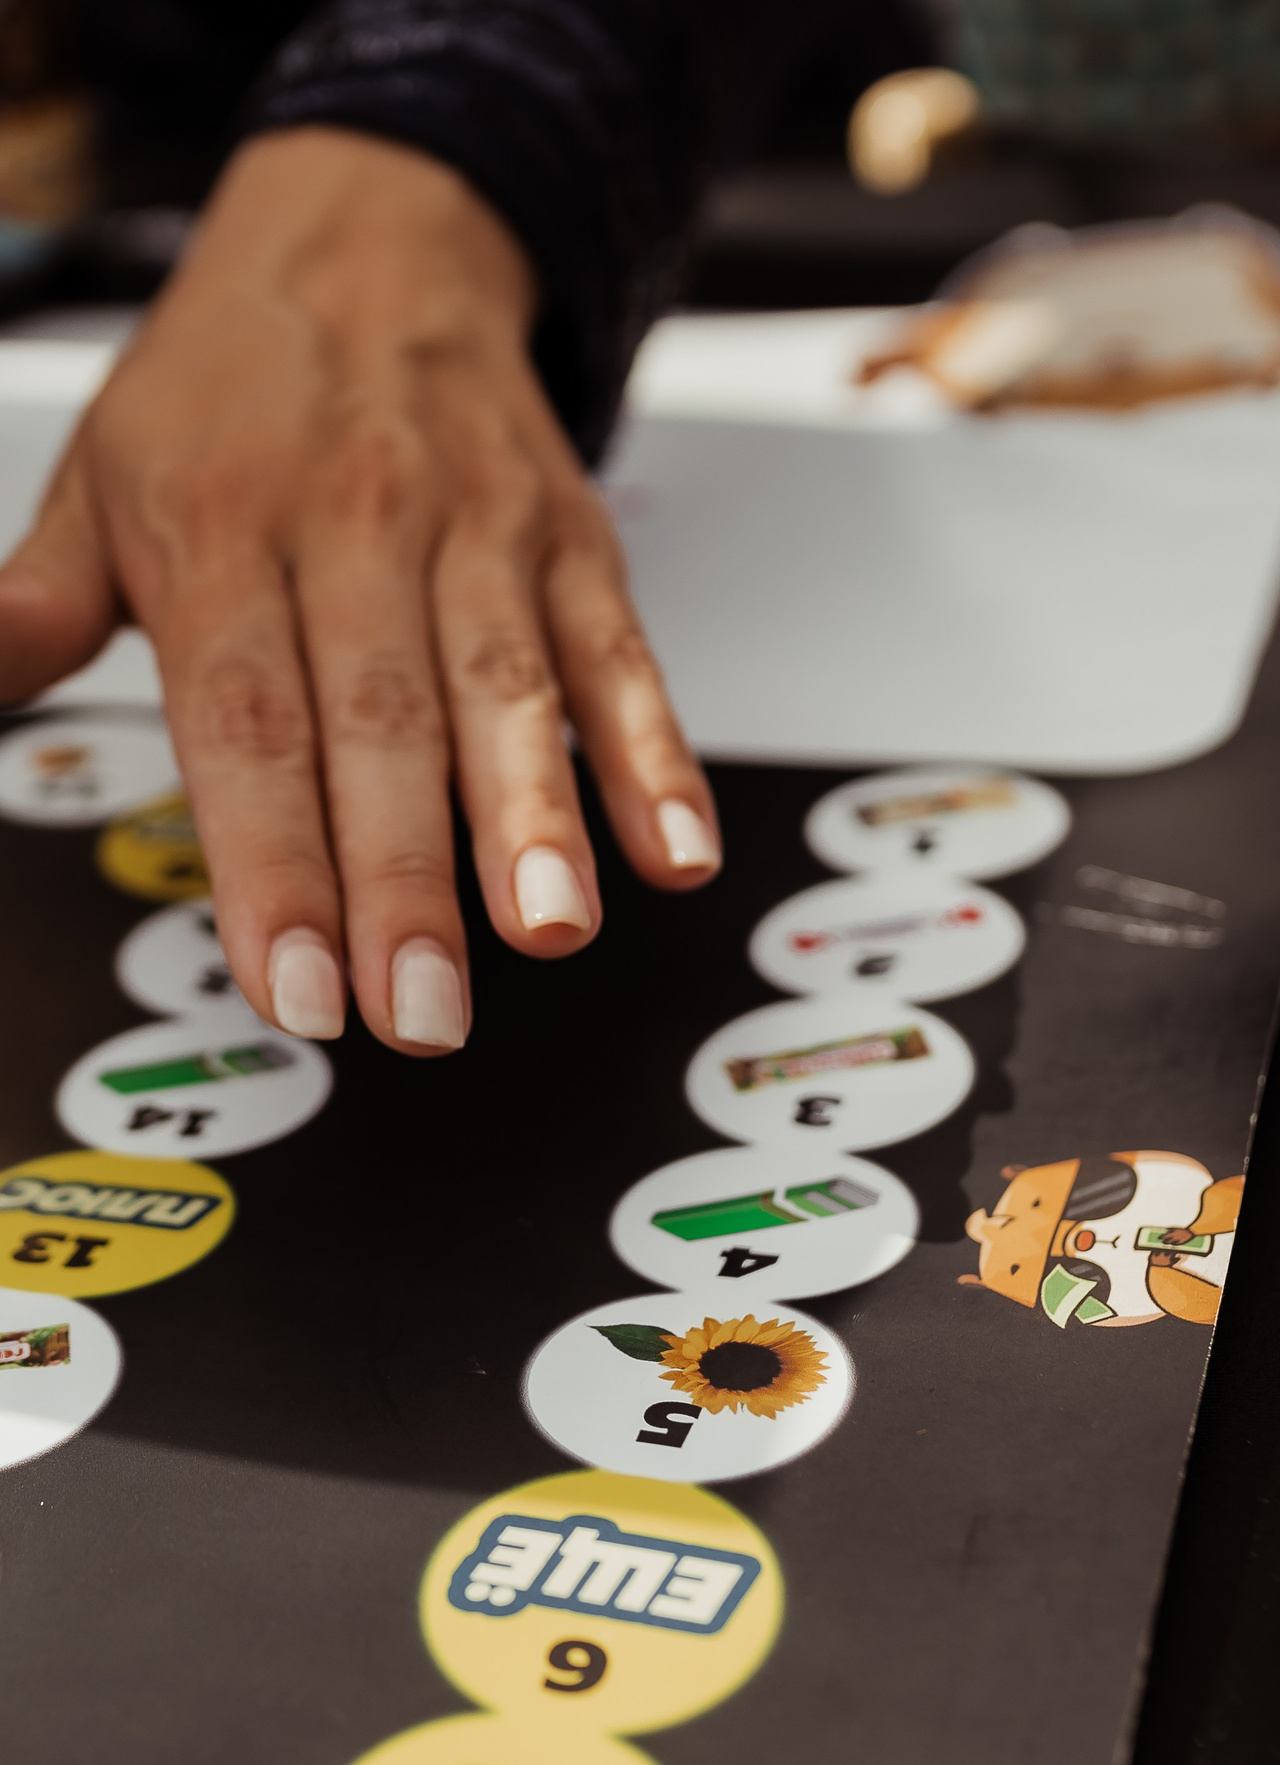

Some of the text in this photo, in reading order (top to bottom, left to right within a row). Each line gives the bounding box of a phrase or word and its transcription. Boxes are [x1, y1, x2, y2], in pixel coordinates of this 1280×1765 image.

[126, 1105, 216, 1139] 14
[792, 1095, 842, 1128] 3
[11, 1231, 110, 1270] 13
[716, 1246, 780, 1280] 4
[635, 1401, 703, 1449] 5
[464, 1524, 744, 1627] ЕЩЁ
[542, 1638, 609, 1695] 6
